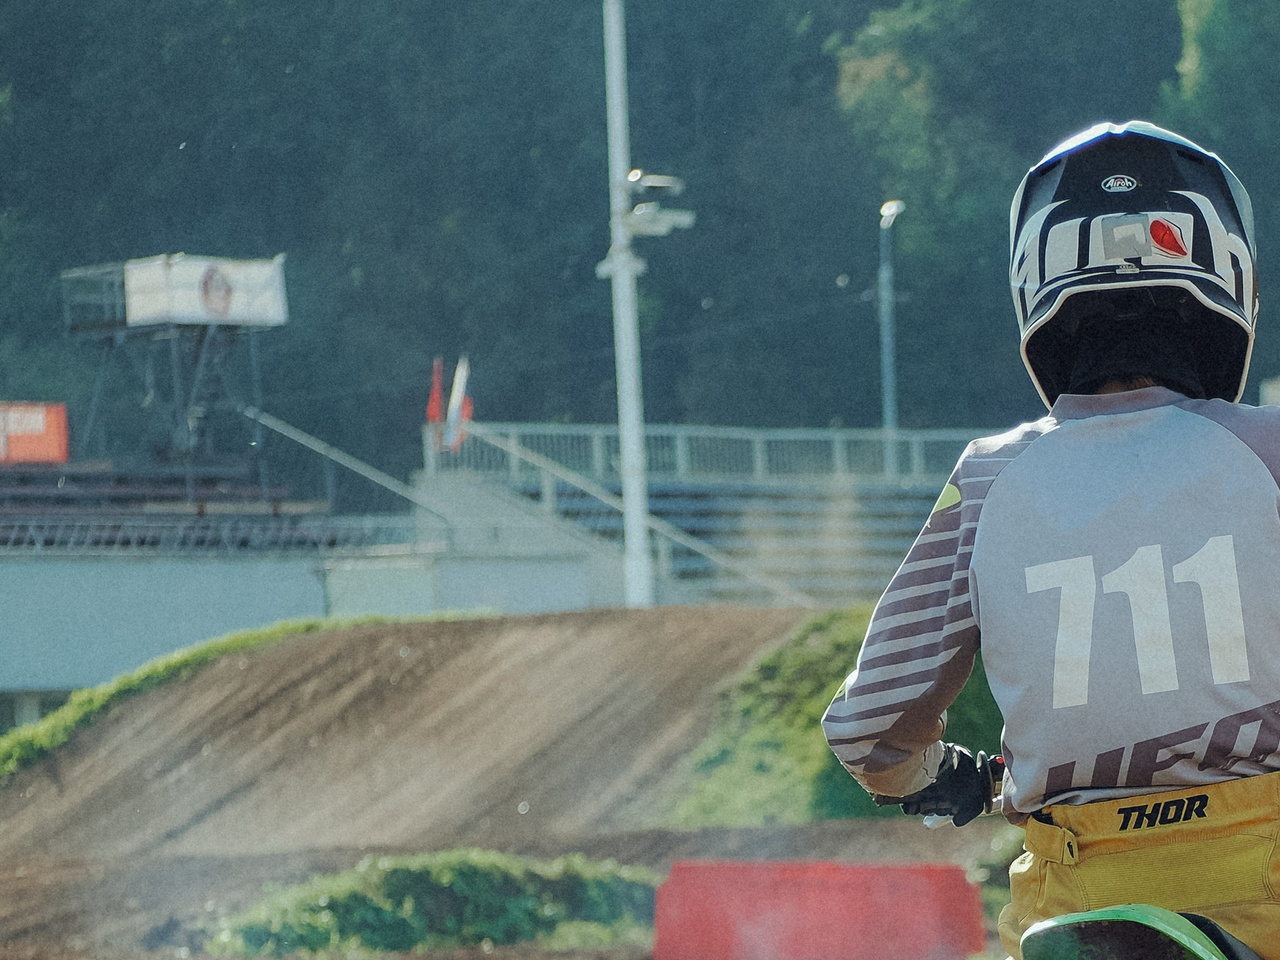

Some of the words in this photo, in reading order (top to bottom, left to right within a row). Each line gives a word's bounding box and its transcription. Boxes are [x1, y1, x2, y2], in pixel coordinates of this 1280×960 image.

[1105, 177, 1133, 188] Airoh
[1024, 534, 1250, 709] 711
[1117, 794, 1209, 831] THOR
